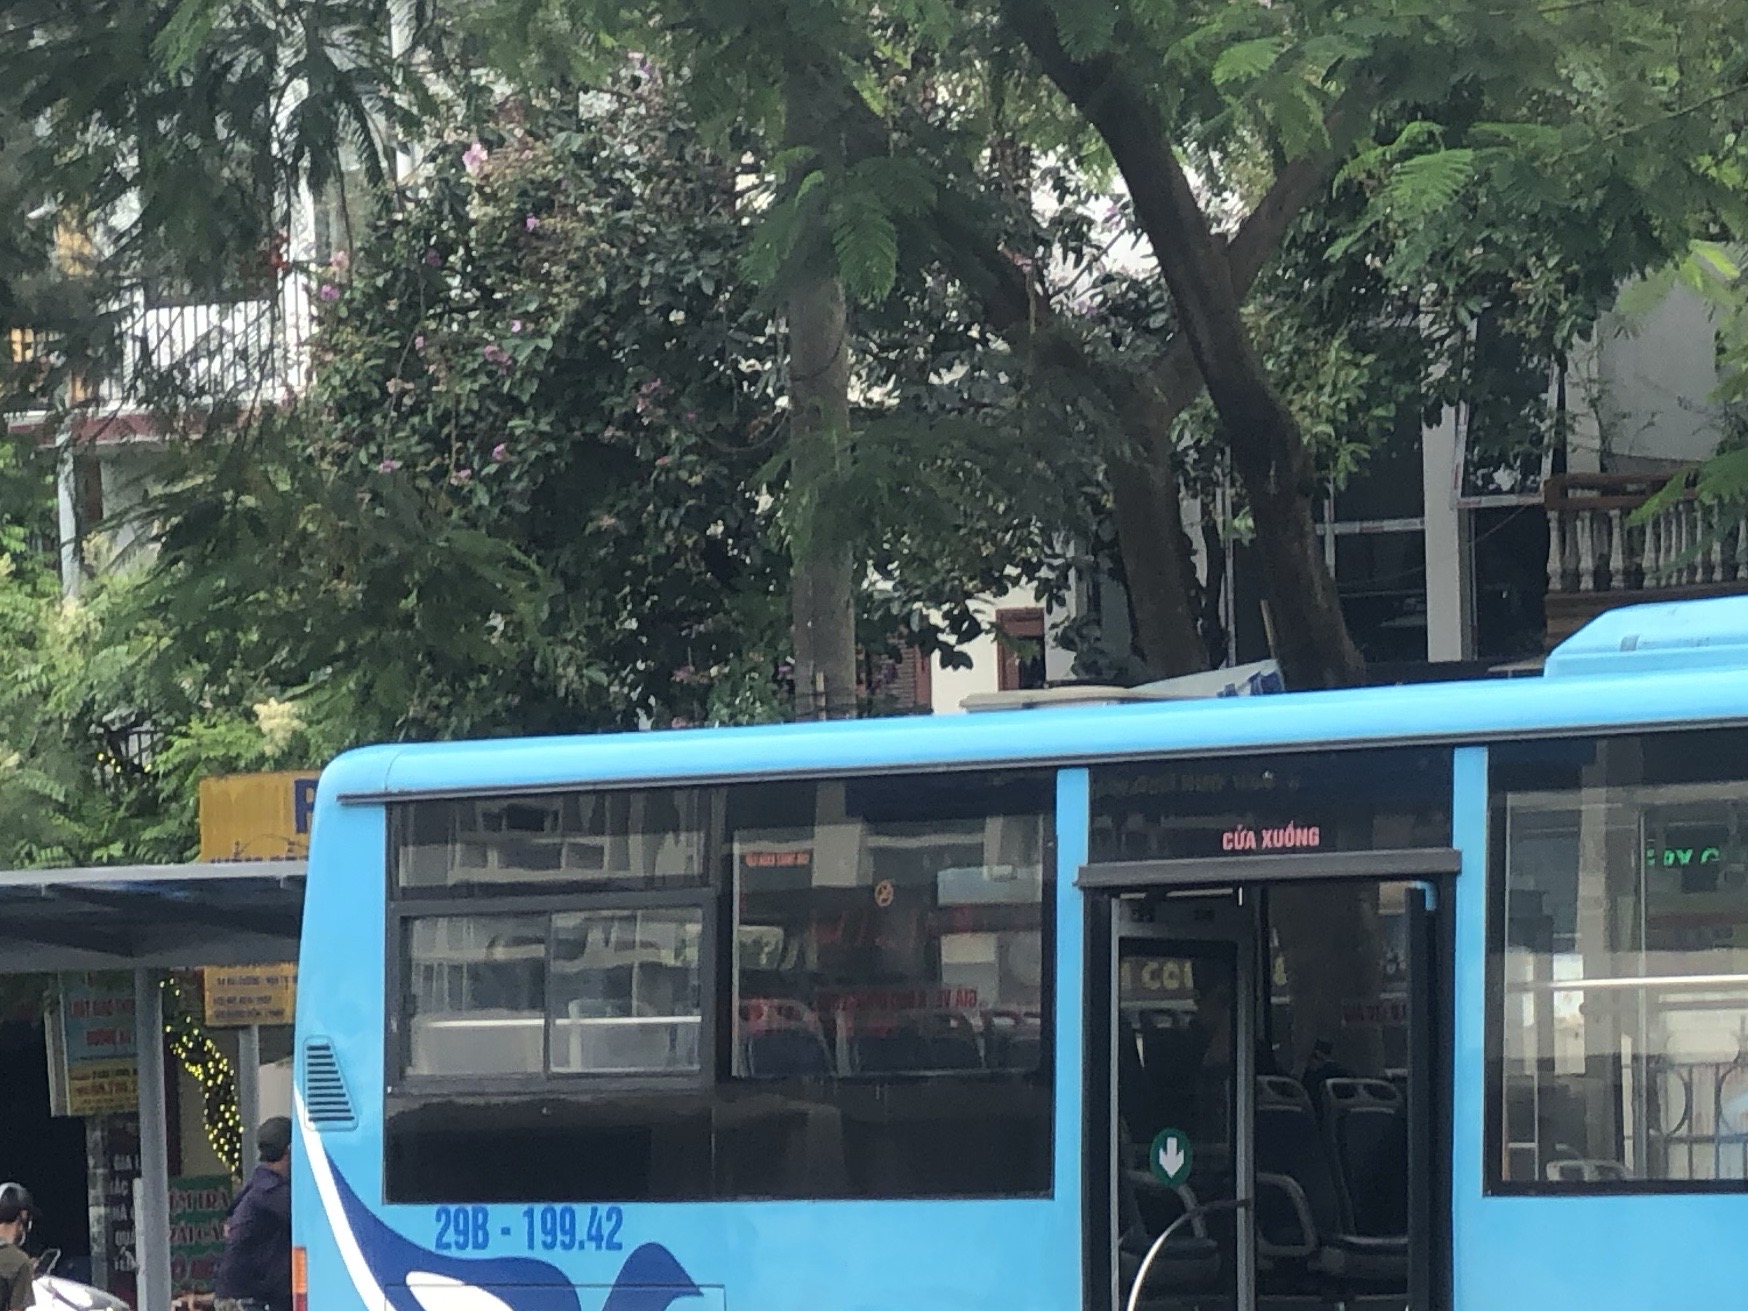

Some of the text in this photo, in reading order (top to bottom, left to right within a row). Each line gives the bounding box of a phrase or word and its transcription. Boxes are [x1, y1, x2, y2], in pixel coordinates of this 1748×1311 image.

[1222, 820, 1320, 851] CỬA XUỐNG
[434, 1205, 490, 1251] 29B
[522, 1205, 623, 1251] 199.42
